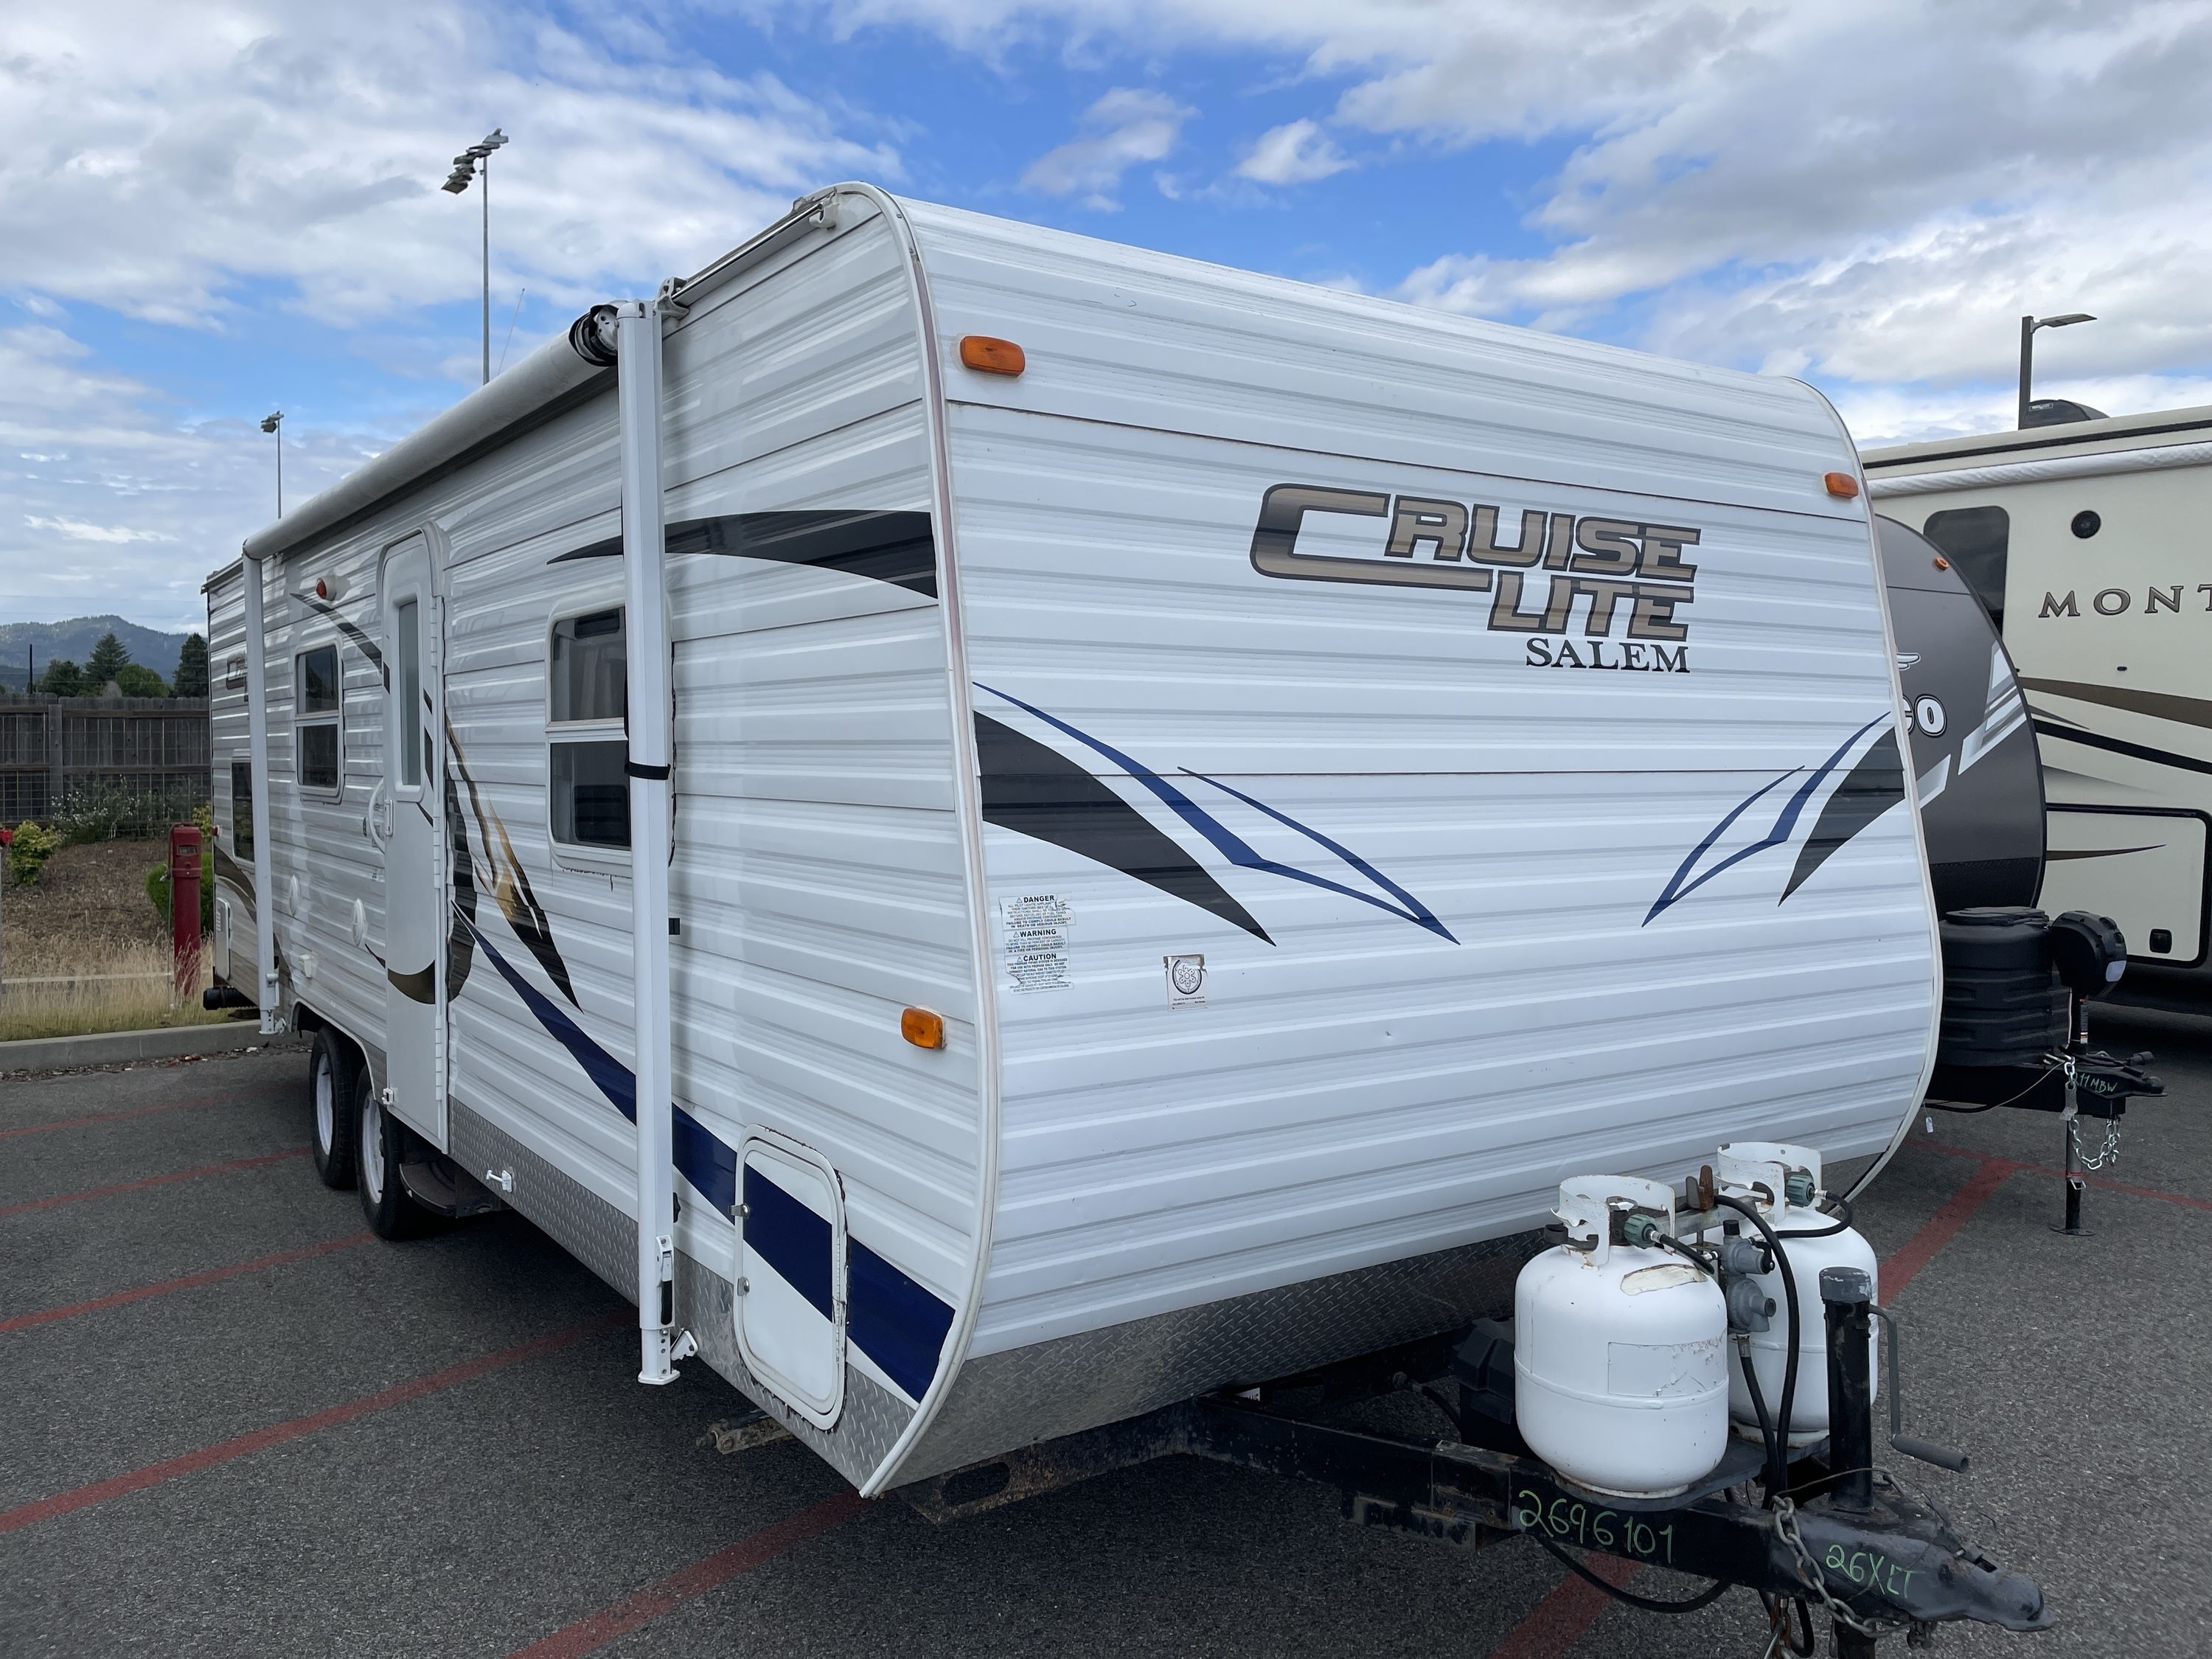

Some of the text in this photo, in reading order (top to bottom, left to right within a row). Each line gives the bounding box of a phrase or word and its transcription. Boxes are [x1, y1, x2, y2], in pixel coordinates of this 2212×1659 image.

[1249, 482, 1701, 592] CRUISE
[1487, 569, 1694, 641] LITE
[1526, 637, 1690, 673] SALEM
[1020, 929, 1056, 937] WARNING
[1519, 1489, 1672, 1564] 2696101
